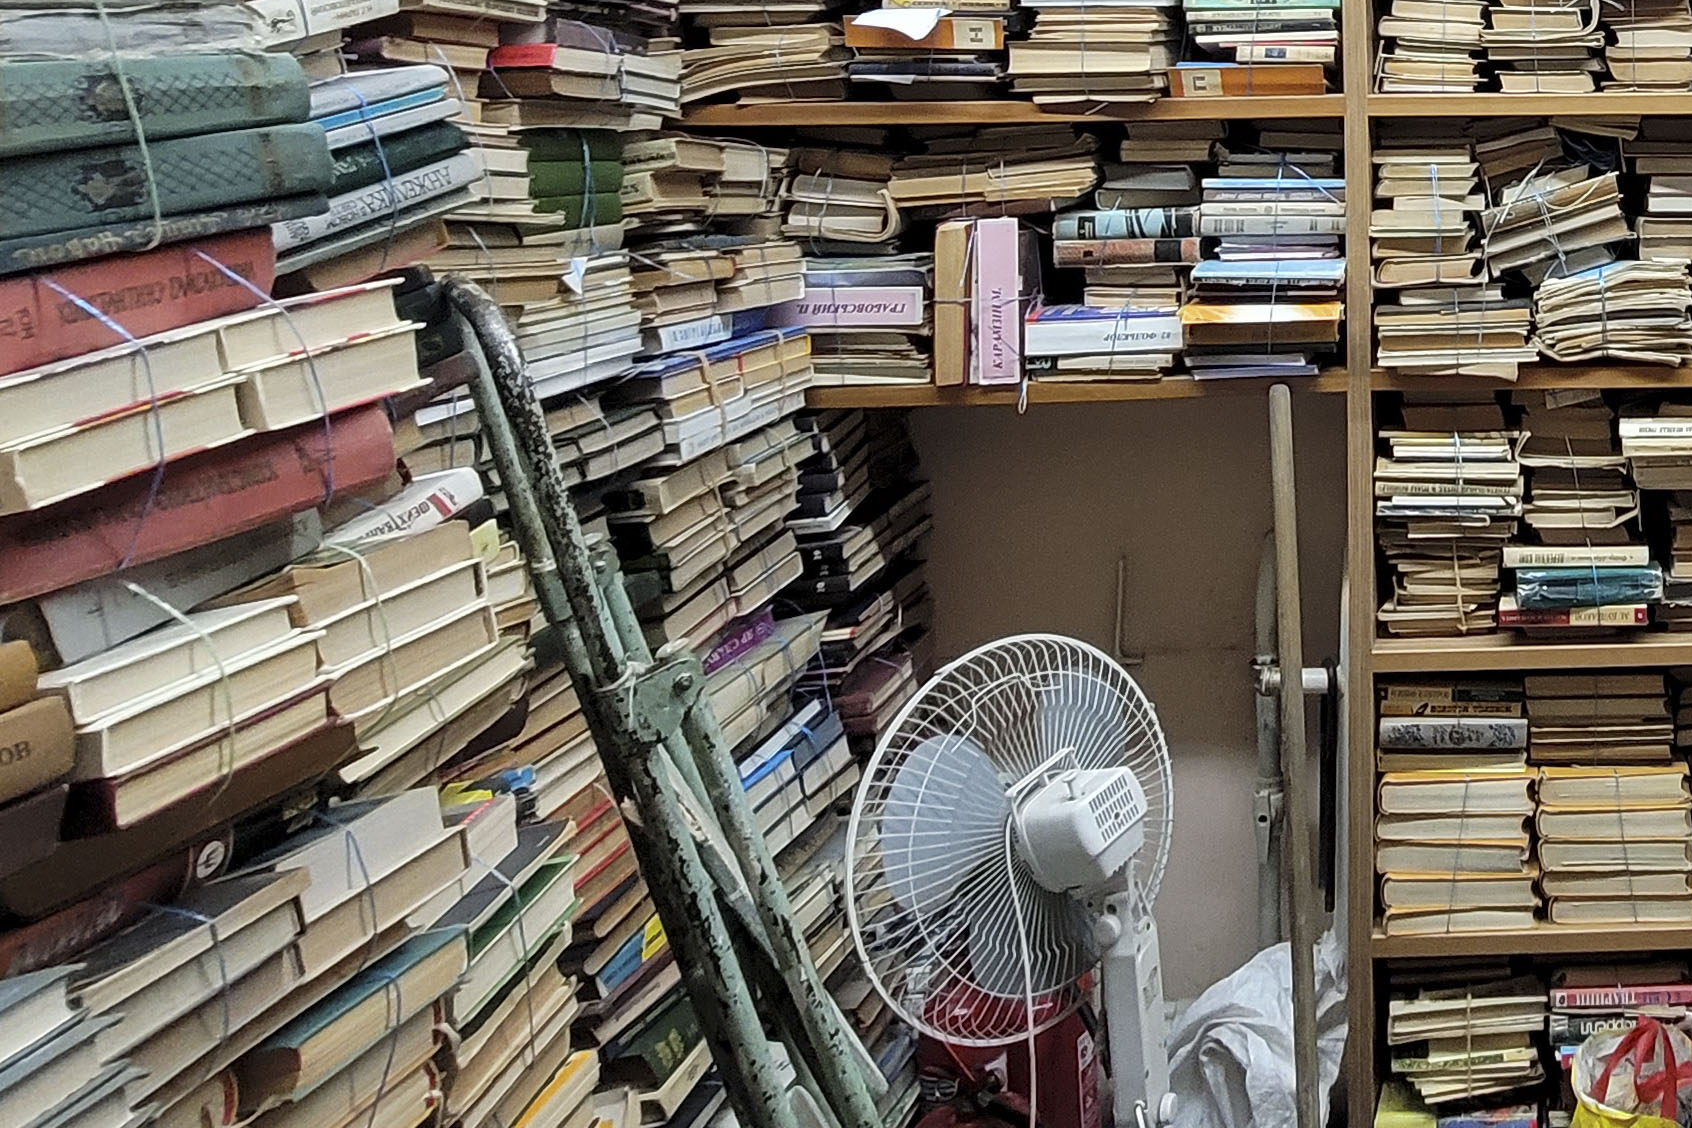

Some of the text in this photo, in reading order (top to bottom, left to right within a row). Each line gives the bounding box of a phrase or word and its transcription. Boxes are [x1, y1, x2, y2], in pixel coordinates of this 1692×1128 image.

[366, 165, 452, 213] АНЖЕЛИКА
[811, 302, 906, 315] ГРАБОВСЬКИЙ
[1103, 331, 1157, 342] ФОЛЬКЛОР
